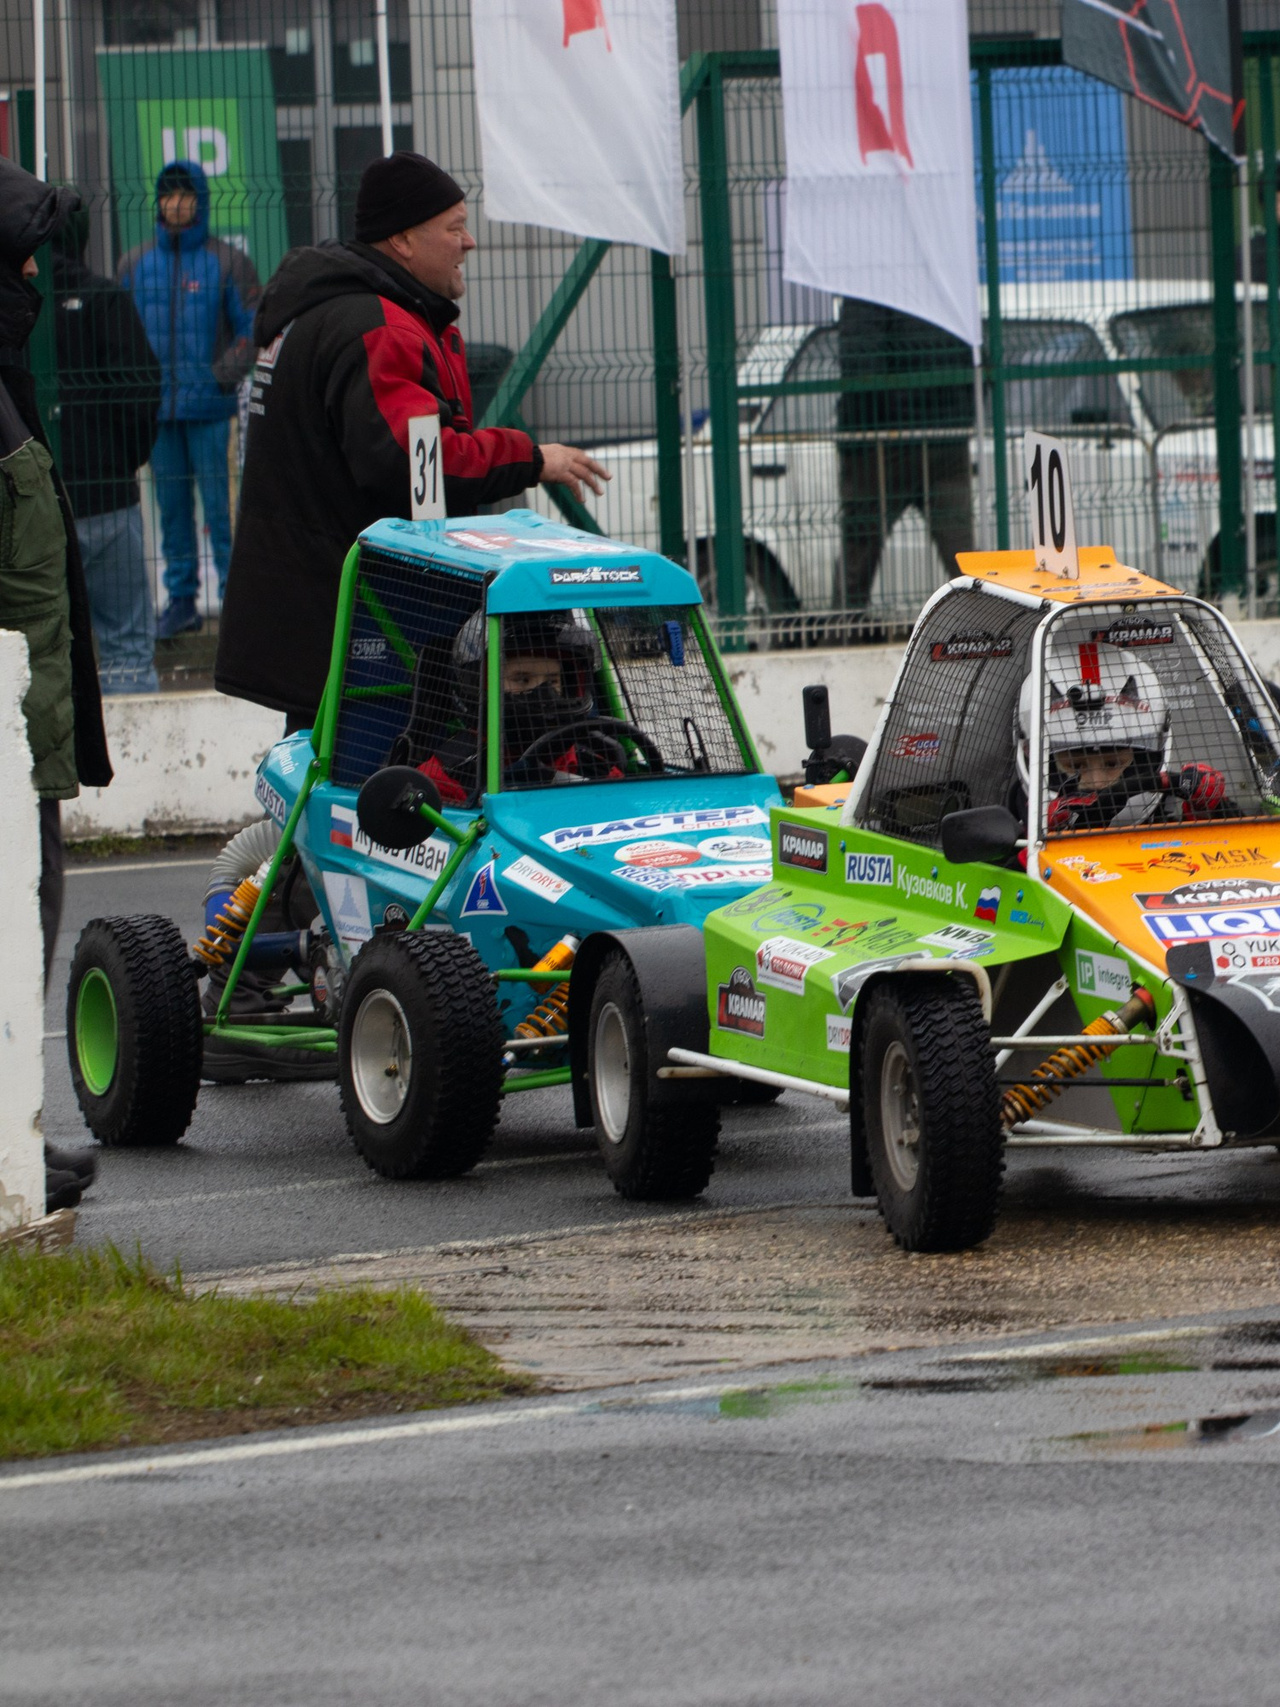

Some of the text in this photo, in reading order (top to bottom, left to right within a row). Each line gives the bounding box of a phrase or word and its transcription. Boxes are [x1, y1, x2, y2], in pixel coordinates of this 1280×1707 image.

[414, 436, 438, 506] 31
[1030, 443, 1066, 553] 10
[1107, 625, 1173, 643] KRAMAR
[257, 777, 285, 821] RUSTA
[554, 808, 756, 845] МАСТЕР
[681, 817, 752, 831] СПОРТ
[404, 843, 447, 873] Иван
[782, 834, 824, 860] КРАМАР
[1200, 847, 1269, 865] MSK
[511, 861, 558, 889] DRYDRY
[848, 855, 893, 883] RUSTA
[897, 862, 969, 911] Кузовков К.
[934, 926, 991, 943] NWB
[1079, 963, 1092, 983] IP
[1256, 957, 1280, 967] PRO
[1098, 967, 1131, 990] integra
[728, 992, 765, 1023] KRAMAR
[829, 1026, 850, 1047] DRYDR
